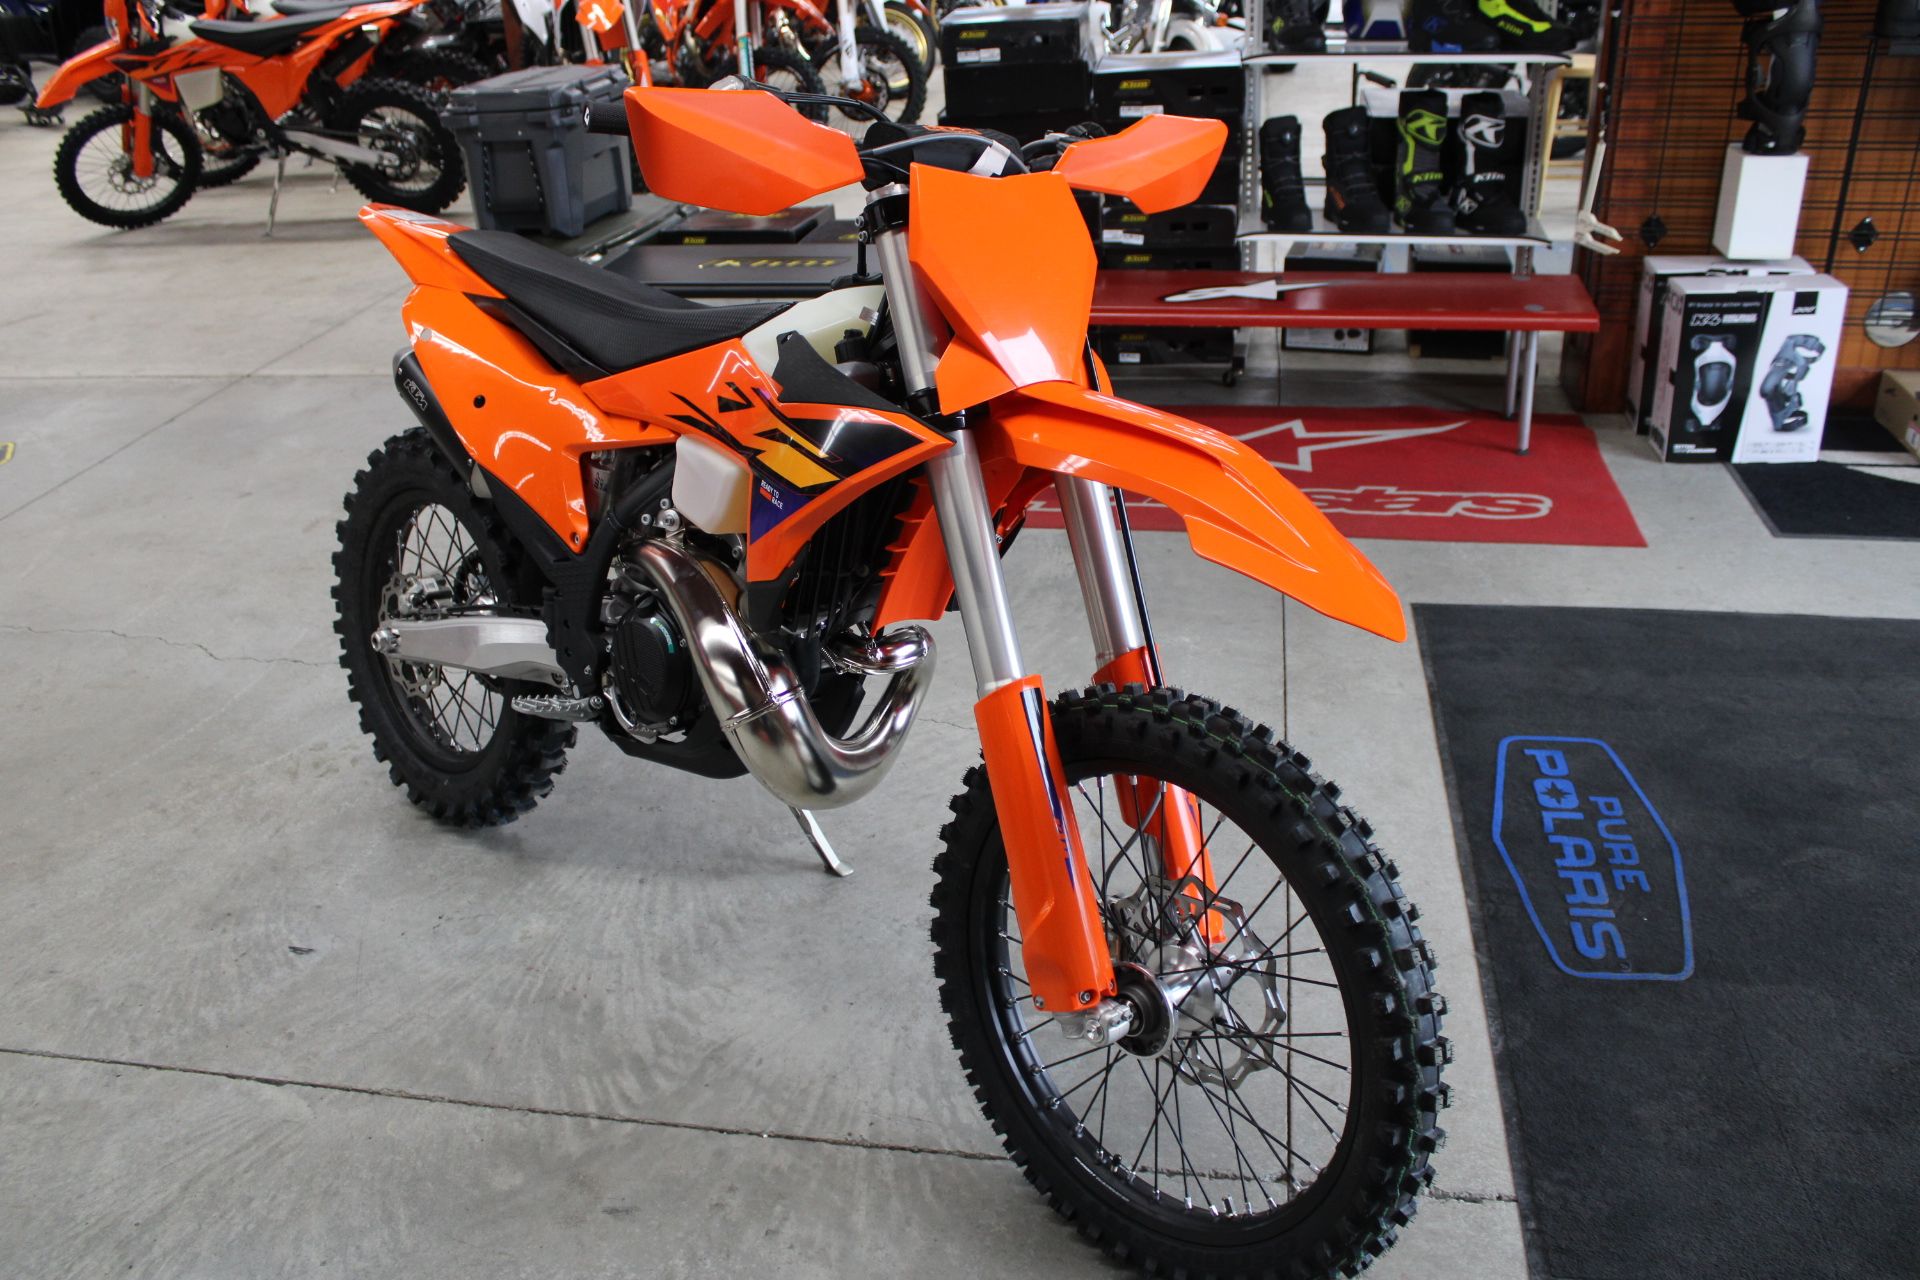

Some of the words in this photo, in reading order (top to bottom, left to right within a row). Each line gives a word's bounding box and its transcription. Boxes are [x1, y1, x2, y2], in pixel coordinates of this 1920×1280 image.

[403, 379, 428, 411] KTM
[760, 480, 774, 494] READY
[773, 489, 780, 499] TO
[771, 496, 784, 510] RACE
[1523, 749, 1627, 960] POLARIS
[1589, 796, 1651, 892] PURE
